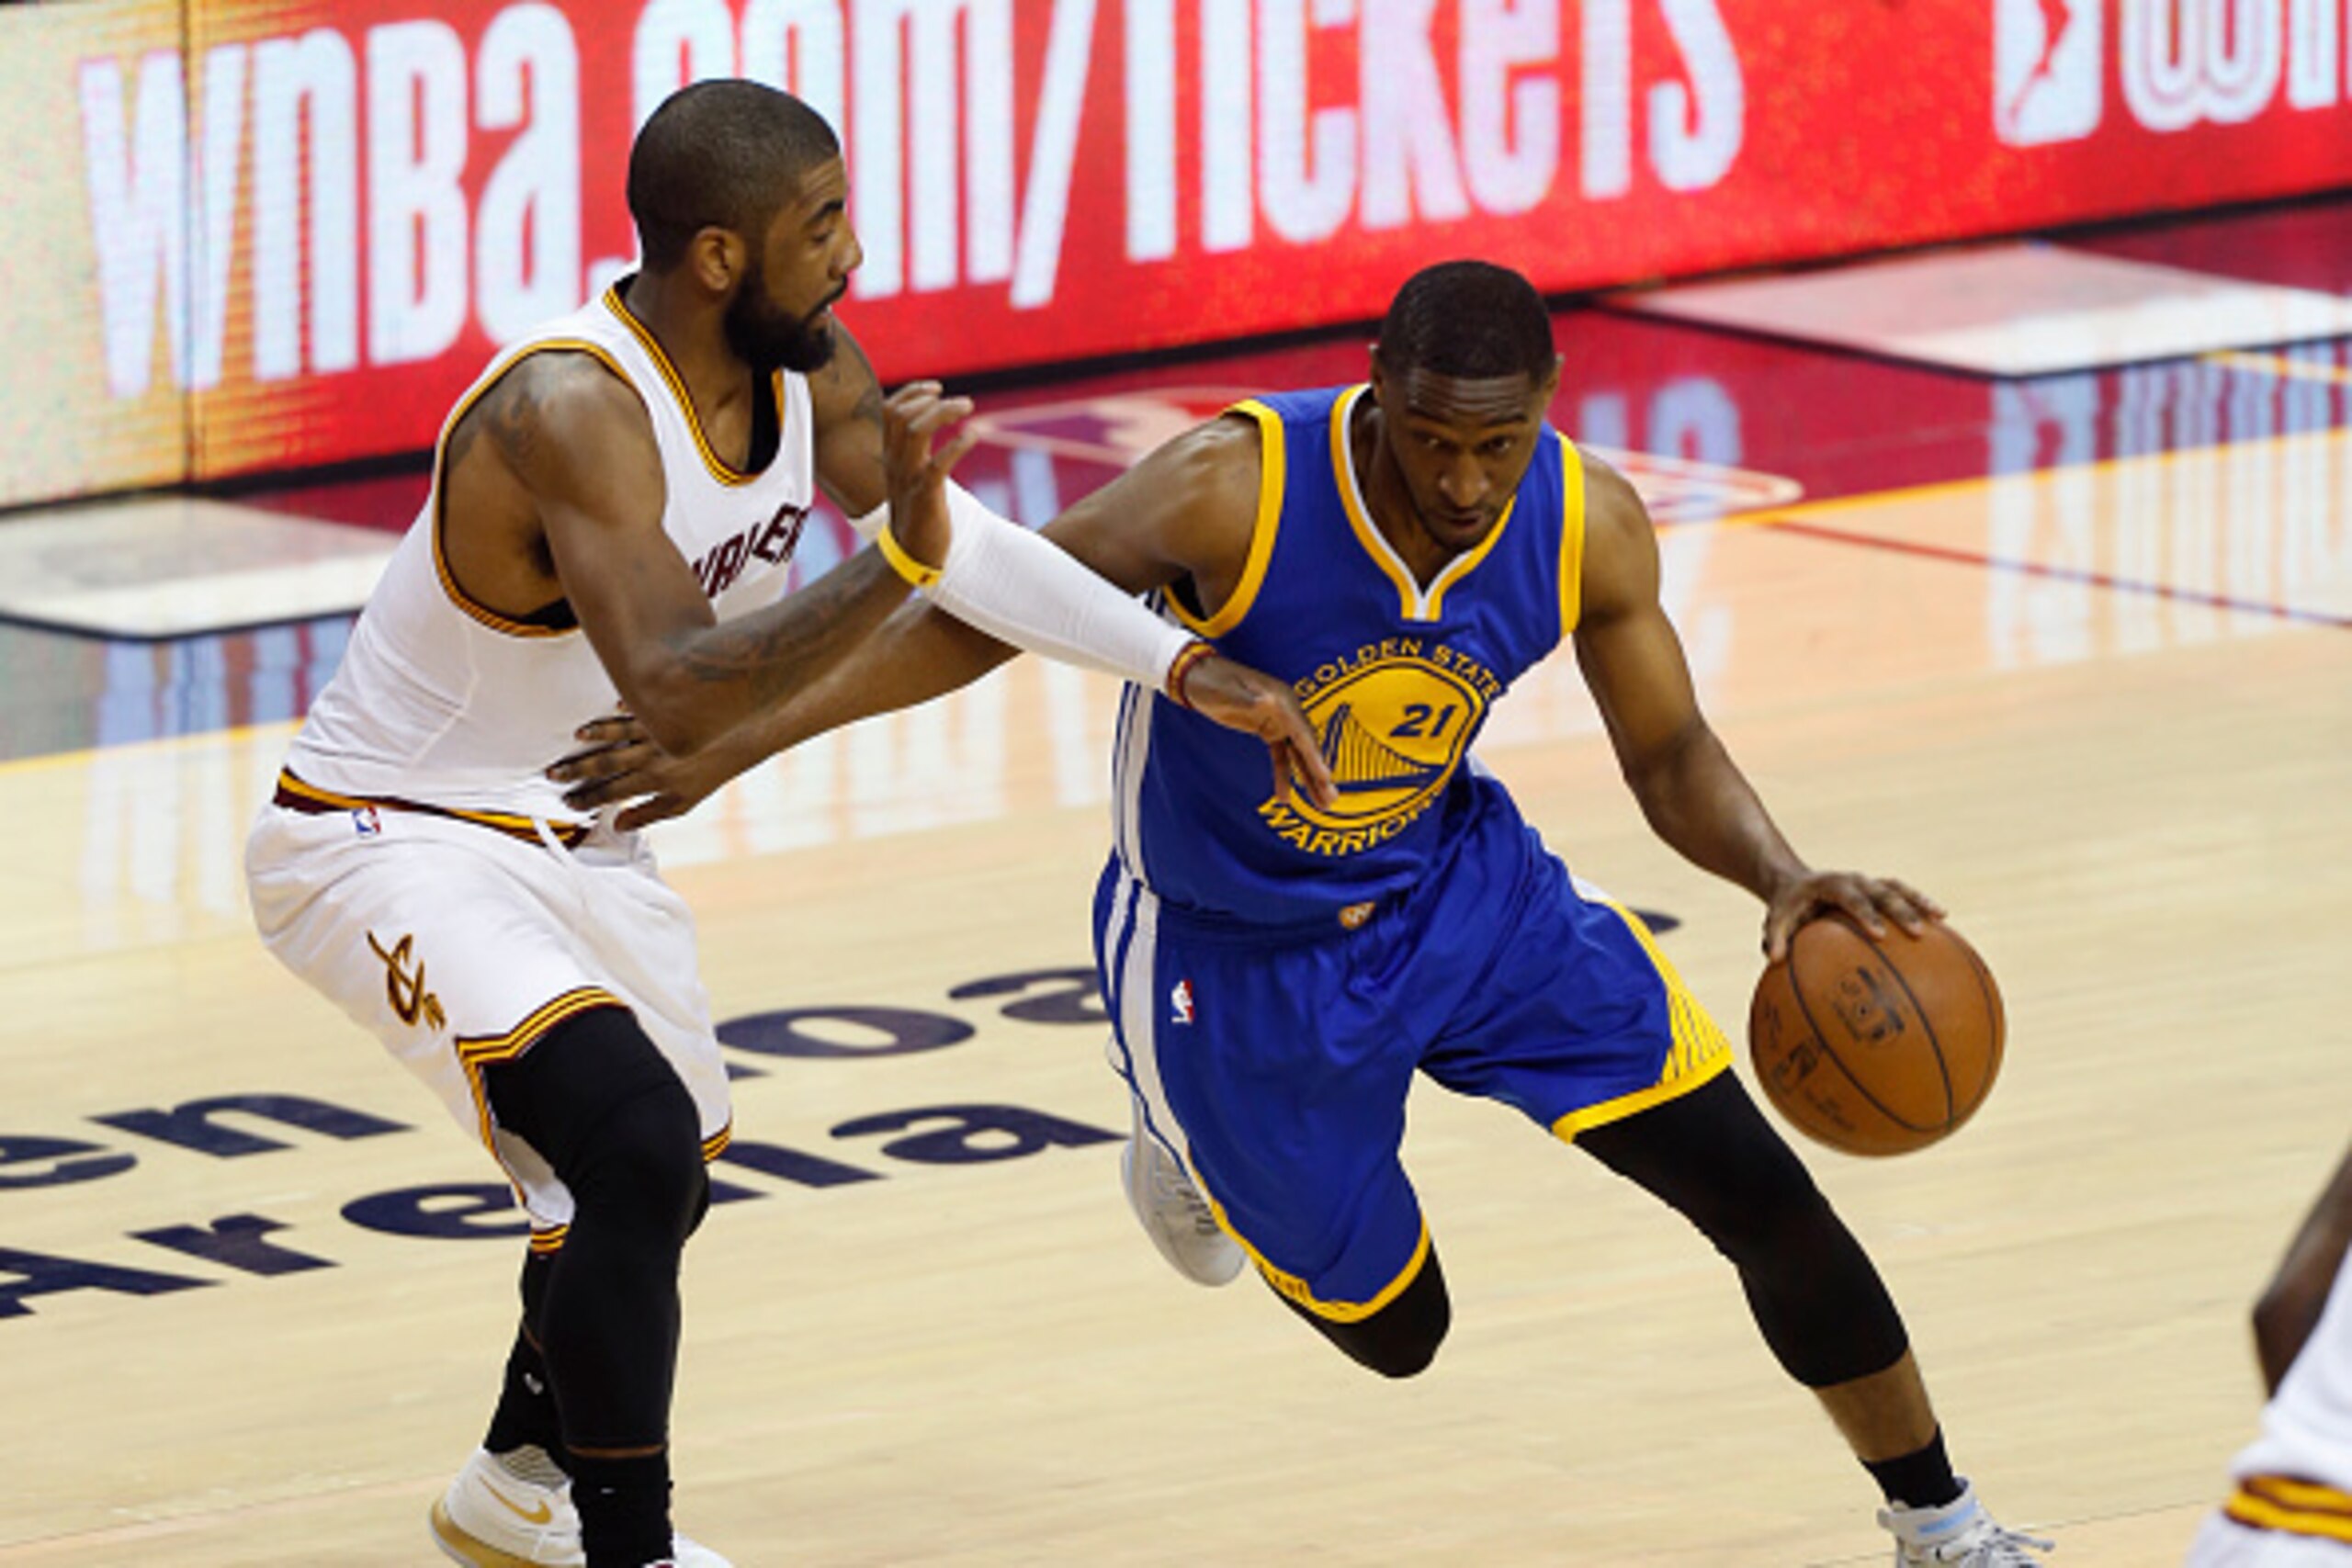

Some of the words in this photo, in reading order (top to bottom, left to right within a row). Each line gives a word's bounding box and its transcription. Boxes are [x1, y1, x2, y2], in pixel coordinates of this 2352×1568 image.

[1294, 638, 1423, 698] GOLDEN
[1433, 644, 1501, 700] STATE
[1389, 703, 1459, 738] 21
[1257, 788, 1439, 856] WARRIO
